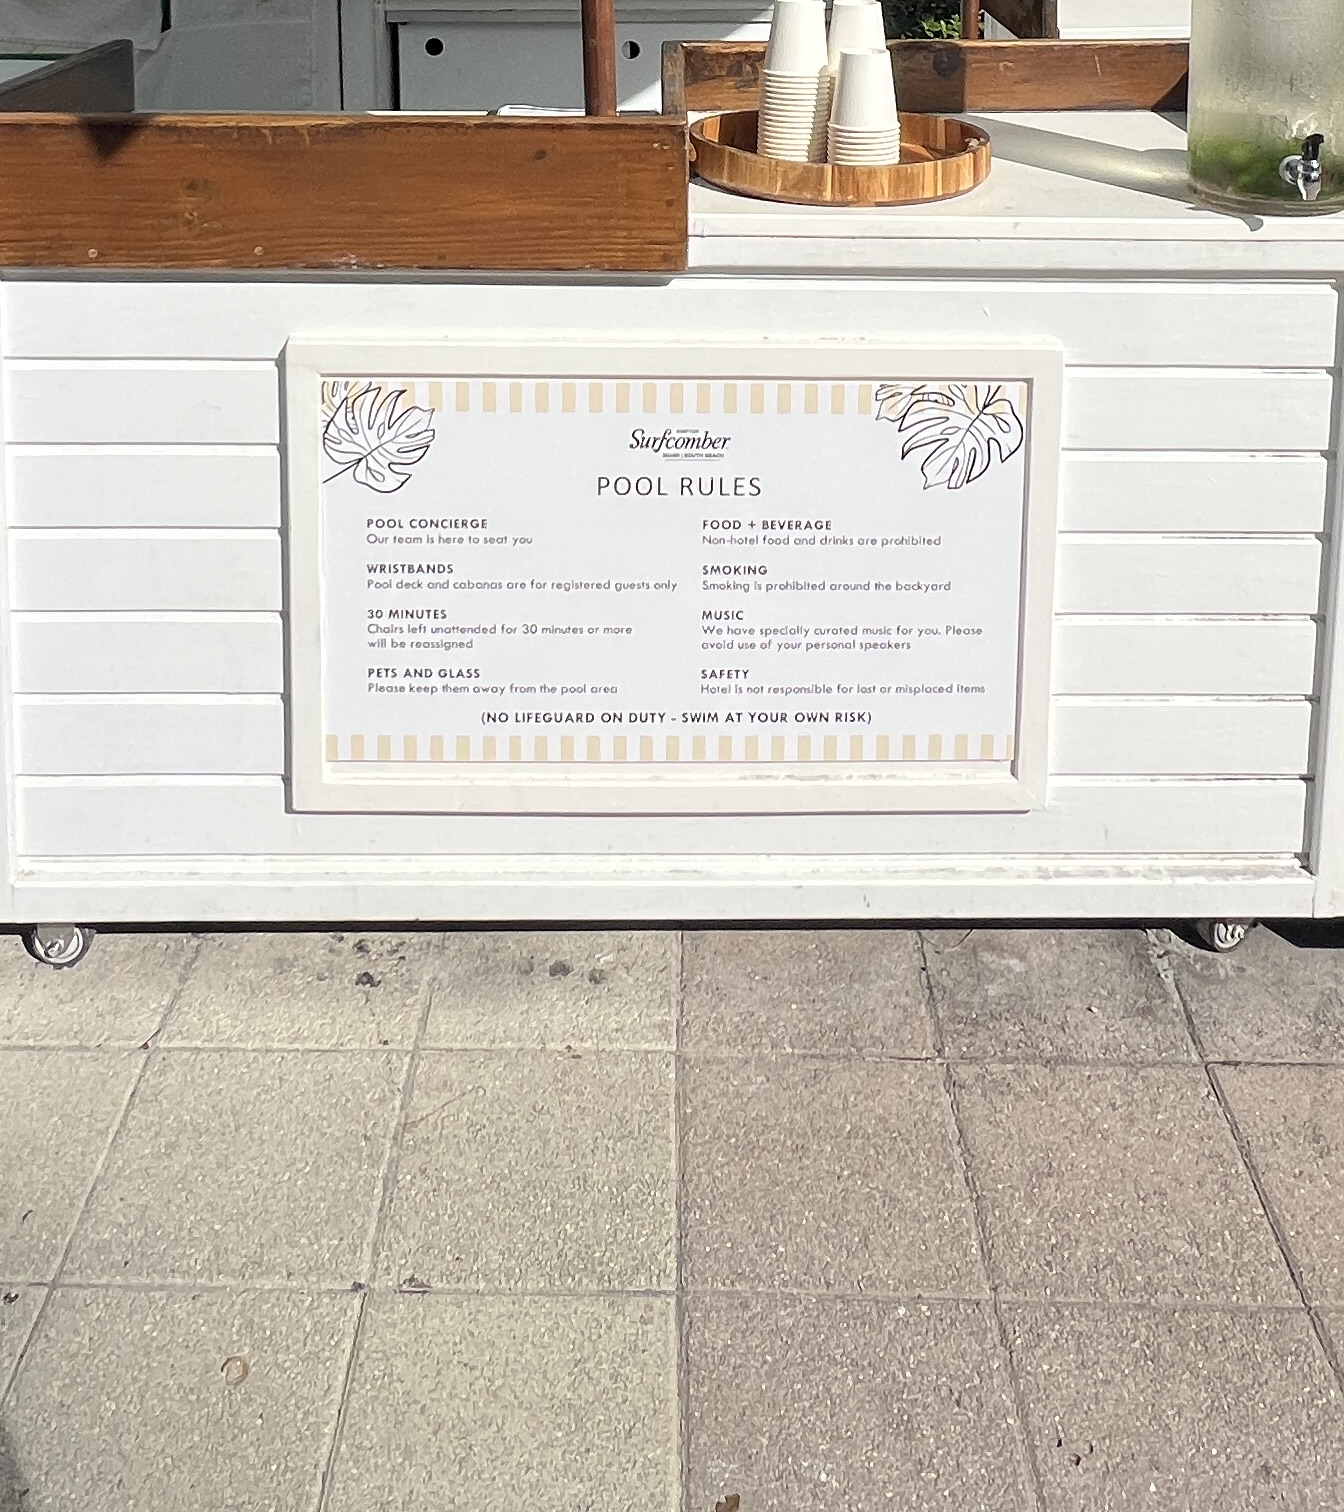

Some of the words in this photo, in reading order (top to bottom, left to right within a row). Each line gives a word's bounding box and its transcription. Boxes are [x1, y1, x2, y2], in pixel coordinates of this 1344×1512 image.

[629, 427, 732, 453] Surfcomber
[597, 476, 669, 497] POOL
[680, 476, 762, 497] RULES
[366, 518, 405, 529] POOL
[408, 518, 488, 530] CONCIERGE
[702, 519, 742, 531] FOOD
[761, 519, 832, 531] BEVERAGE
[365, 533, 390, 545] Our
[392, 535, 423, 545] team
[425, 533, 435, 545] is
[437, 533, 465, 545] here
[467, 535, 481, 545] to
[483, 535, 508, 545] seat
[511, 536, 534, 548] you
[701, 534, 759, 546] Non-hotel
[762, 533, 790, 546] food
[793, 534, 816, 546] and
[819, 534, 854, 546] drinks
[857, 537, 878, 546] are
[880, 534, 942, 549] prohibited
[366, 563, 454, 575] WRISTBANDS
[702, 564, 768, 576] SMOKING
[366, 578, 393, 590] Pool
[395, 578, 424, 590] deck
[426, 578, 450, 590] and
[452, 578, 504, 590] cabanas
[506, 581, 527, 590] are
[530, 578, 548, 591] for
[550, 578, 611, 593] registered
[614, 581, 651, 593] guests
[653, 579, 678, 593] only
[701, 579, 751, 594] Smoking
[753, 580, 763, 591] is
[765, 579, 826, 594] prohibited
[829, 580, 871, 592] around
[874, 580, 892, 591] the
[895, 580, 952, 594] backyard
[366, 608, 384, 620] 30
[387, 608, 448, 620] MINUTES
[701, 609, 745, 621] MUSIC
[366, 623, 405, 635] Chairs
[407, 622, 427, 635] left
[430, 623, 497, 635] unattended
[500, 623, 518, 635] for
[521, 623, 538, 635] 30
[540, 624, 584, 635] minutes
[586, 626, 600, 635] or
[602, 627, 633, 635] more
[701, 624, 724, 636] We
[726, 624, 756, 636] have
[759, 624, 811, 639] specially
[813, 625, 859, 636] curated
[861, 625, 893, 636] music
[896, 624, 914, 636] for
[945, 624, 983, 636] Please
[366, 637, 387, 649] will
[390, 637, 407, 649] be
[409, 637, 474, 652] reassigned
[701, 639, 735, 650] avoid
[737, 641, 757, 651] use
[759, 638, 773, 650] of
[775, 640, 803, 653] your
[805, 638, 857, 653] personal
[859, 639, 912, 653] speakers
[367, 667, 398, 679] PETS
[402, 667, 434, 679] AND
[437, 667, 481, 679] GLASS
[700, 668, 750, 680] SAFETY
[367, 682, 406, 694] Please
[408, 682, 439, 696] keep
[441, 682, 470, 694] them
[472, 685, 507, 697] away
[509, 682, 537, 695] from
[539, 683, 558, 694] the
[560, 683, 587, 696] pool
[590, 685, 618, 694] area
[700, 683, 732, 695] Hotel
[734, 683, 744, 695] is
[746, 685, 765, 695] not
[767, 683, 833, 697] responsible
[836, 683, 854, 695] for
[856, 683, 877, 694] lost
[879, 685, 893, 695] or
[894, 683, 954, 697] misplaced
[956, 683, 986, 694] items
[480, 711, 510, 726] (NO
[514, 711, 595, 724] LIFEGUARD
[600, 711, 623, 724] ON
[628, 711, 667, 724] DUTY
[681, 711, 720, 724] SWIM
[724, 711, 744, 724] AT
[747, 711, 789, 724] YOUR
[794, 711, 830, 724] OWN
[834, 711, 872, 726] RISK)
